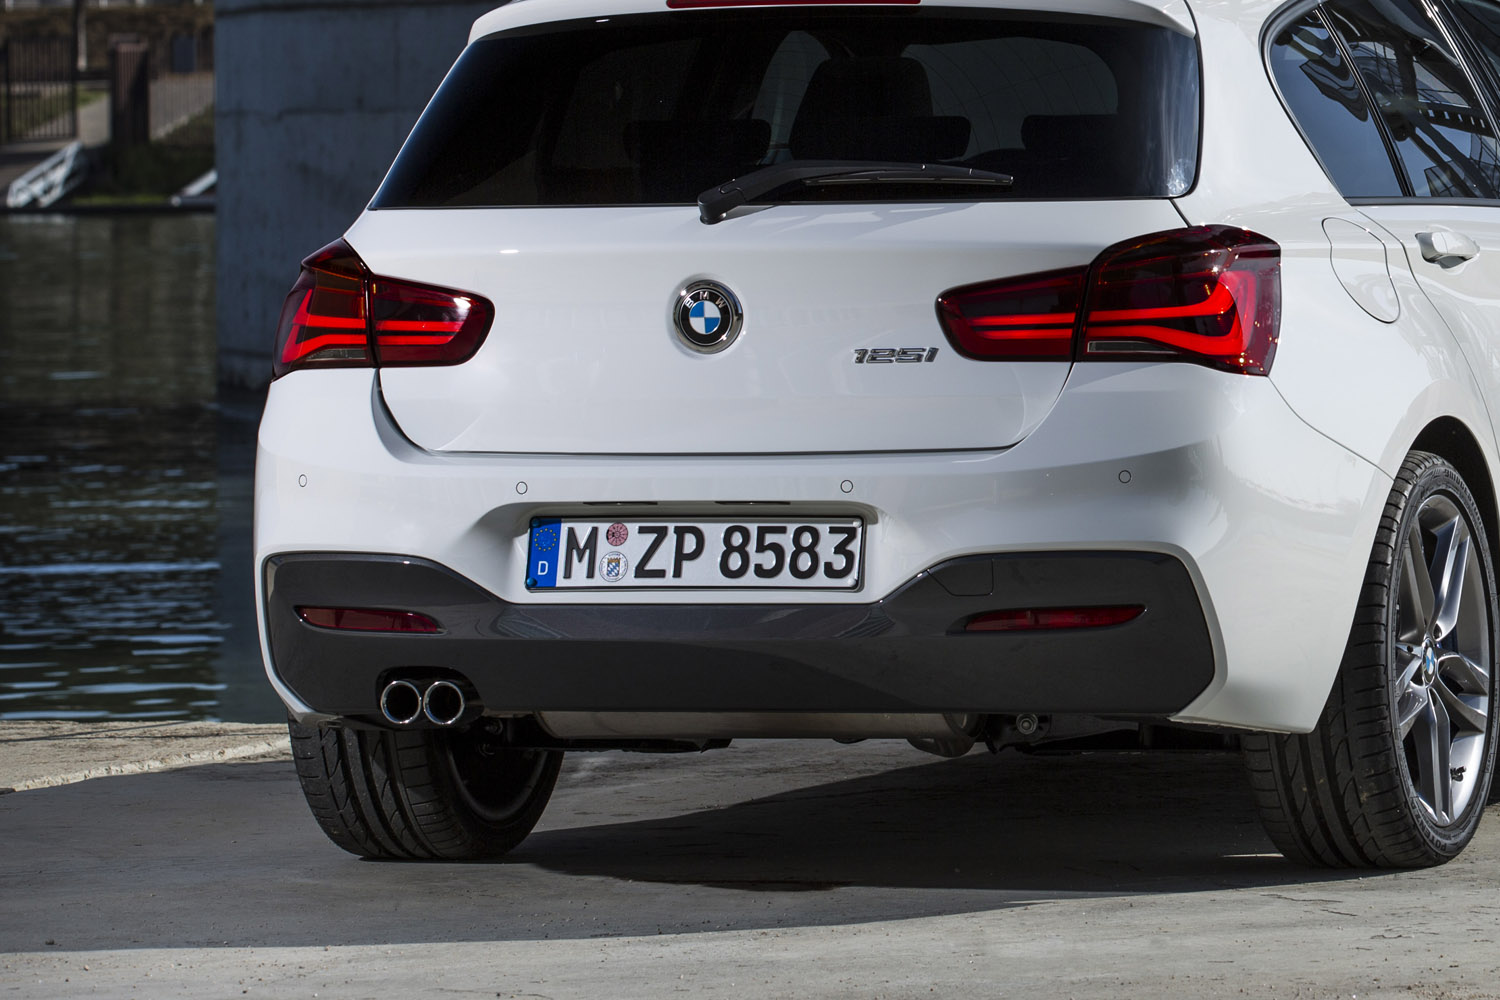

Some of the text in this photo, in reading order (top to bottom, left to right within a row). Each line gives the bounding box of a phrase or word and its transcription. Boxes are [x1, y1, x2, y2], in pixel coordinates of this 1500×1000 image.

[684, 290, 727, 308] BMW
[563, 526, 599, 579] M
[634, 526, 705, 579] ZP
[719, 525, 858, 580] 8583
[537, 560, 549, 576] D
